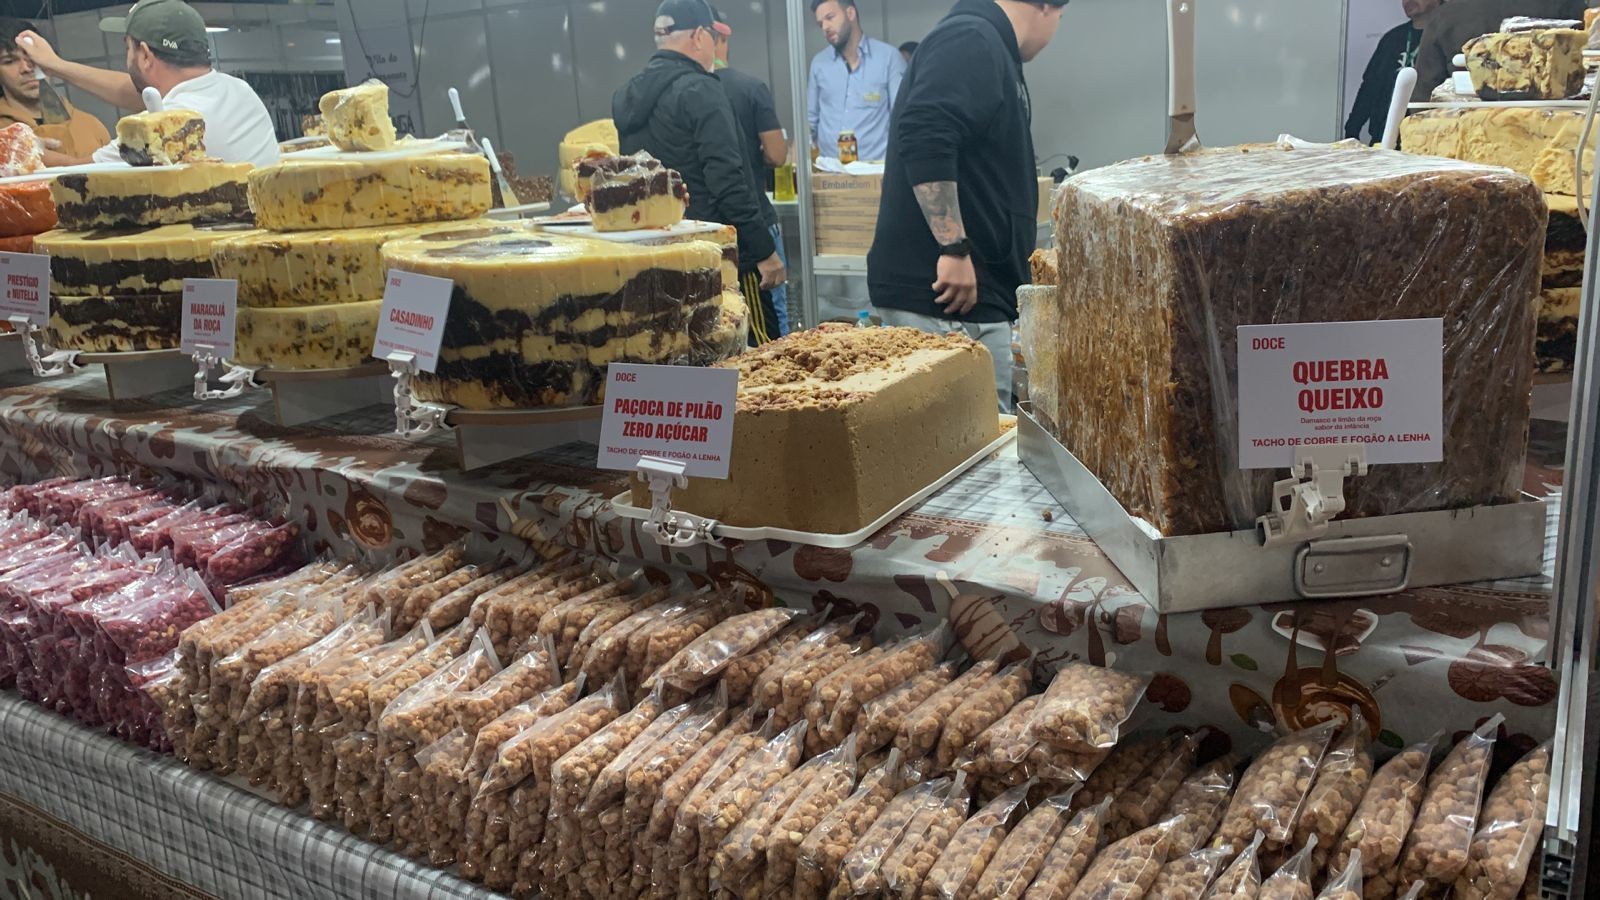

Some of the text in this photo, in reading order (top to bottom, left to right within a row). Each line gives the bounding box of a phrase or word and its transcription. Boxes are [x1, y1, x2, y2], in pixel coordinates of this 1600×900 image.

[12, 288, 39, 301] NUTELLA
[191, 302, 225, 317] MARACUJÁ
[193, 318, 220, 334] DA ROÇA
[390, 308, 434, 331] CASADINHO
[1252, 337, 1286, 350] DOCE
[615, 372, 637, 382] DOCE
[1292, 358, 1389, 385] QUEBRA
[1298, 386, 1384, 413] QUEIXO
[614, 398, 722, 420] PAÇOCA DE PILÃO
[622, 421, 708, 442] ZERO AÇÚCAR
[1344, 422, 1370, 430] infância
[1252, 433, 1431, 447] TACHO DE COBRE E FOGÃO A LENHA
[606, 446, 628, 454] TACHO
[638, 449, 661, 457] COBRE
[668, 450, 691, 459] FOGÃO
[692, 452, 697, 460] A
[698, 454, 721, 462] LENHA
